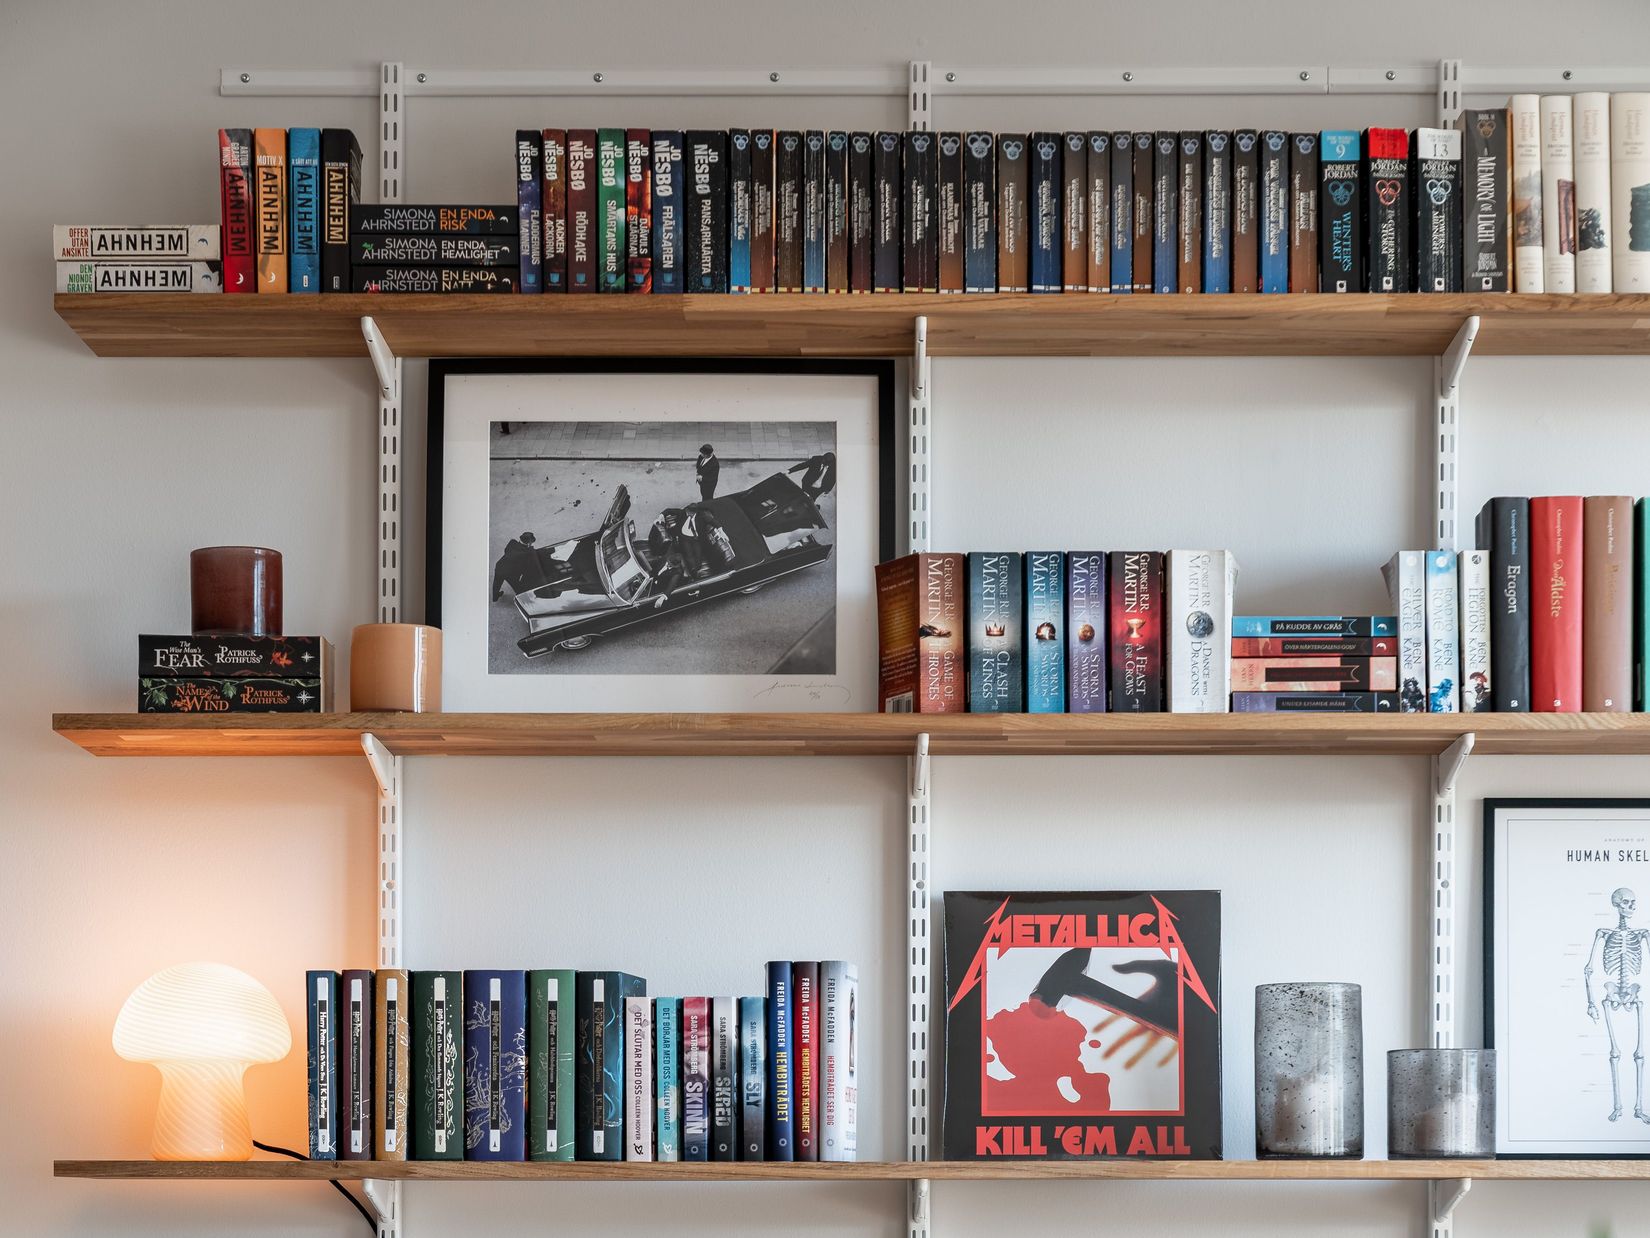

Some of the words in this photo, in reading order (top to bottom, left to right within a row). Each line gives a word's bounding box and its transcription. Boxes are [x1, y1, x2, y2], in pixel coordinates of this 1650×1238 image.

[256, 155, 276, 165] MOTIV
[278, 155, 284, 164] X
[518, 141, 533, 182] NESBØ
[530, 145, 539, 157] JO
[544, 140, 558, 181] NESBØ
[556, 144, 564, 156] JO
[584, 145, 594, 160] JO
[614, 145, 624, 158] JO
[628, 140, 643, 183] NESBØ
[640, 144, 649, 157] JO
[669, 145, 682, 161] JO
[708, 148, 719, 163] JO
[569, 140, 586, 191] NESBØ
[600, 141, 616, 187] NESBØ
[653, 140, 673, 197] NESBØ
[693, 144, 711, 195] NESBØ
[1322, 168, 1359, 182] JORDAN
[1476, 156, 1497, 201] MEMORY
[361, 219, 436, 230] AHRNSTEDT
[440, 219, 467, 231] RISK
[384, 208, 436, 220] SIMONA
[440, 208, 456, 220] EN
[461, 208, 496, 220] ENDA
[69, 228, 89, 238] OFFER
[530, 209, 540, 265] FLADDERMUS
[544, 213, 554, 260] LACKORNA
[555, 219, 565, 254] KACKER
[574, 211, 589, 262] RÖDHAKE
[662, 205, 674, 269] FRÄLSAREN
[700, 199, 714, 275] PANSARHJÄRTA
[1332, 220, 1342, 262] HEART
[1477, 213, 1497, 244] LIGHT
[62, 248, 89, 257] ANSIKTE
[71, 238, 89, 247] UTAN
[362, 249, 438, 260] AHRNSTEDT
[441, 250, 500, 260] HEMLIGHET
[385, 238, 437, 249] SIMONA
[441, 241, 456, 250] EN
[458, 241, 486, 250] ENDA
[79, 264, 93, 273] DEN
[386, 269, 438, 281] SIMONA
[442, 269, 459, 281] EN
[462, 269, 497, 281] ENDA
[606, 252, 617, 272] HUS
[67, 283, 93, 292] GRAVEN
[68, 274, 93, 283] NIONDE
[363, 280, 438, 292] AHRNSTEDT
[442, 280, 474, 292] NATT
[927, 558, 943, 623] MARTIN
[982, 555, 999, 622] MARTIN
[1072, 557, 1089, 622] MARTIN
[1124, 554, 1140, 613] MARTIN
[1188, 554, 1201, 609] MARTIN
[1504, 565, 1521, 614] Eragon
[1412, 587, 1422, 631] SILVER
[1468, 588, 1479, 633] LEGION
[153, 648, 206, 668] FEAR
[214, 652, 264, 664] ROTHFUSS
[218, 645, 257, 657] PATRICK
[982, 658, 995, 699] KINGS
[996, 652, 1010, 698] CLASH
[1125, 660, 1136, 696] CROWS
[1136, 655, 1148, 695] FEAST
[1191, 641, 1203, 697] DRAGONS
[240, 693, 291, 705] ROTHFUSS
[244, 685, 283, 697] PATRICK
[1567, 849, 1610, 862] HUMAN
[1618, 849, 1649, 862] SKEL
[777, 981, 785, 1008] FREIDA
[801, 977, 810, 1004] FREIDA
[827, 977, 836, 1003] FREIDA
[319, 1011, 327, 1028] Harry
[634, 1011, 642, 1027] DET
[662, 1007, 670, 1020] DET
[690, 1015, 698, 1032] SARA
[719, 1016, 727, 1034] SARA
[801, 1005, 810, 1044] McFADDEN
[827, 1005, 835, 1043] McFADDEN
[319, 1028, 328, 1046] Potter
[662, 1021, 671, 1051] BÖRJAR
[777, 1009, 786, 1048] McFADDEN
[633, 1028, 643, 1058] SLUTAR
[690, 1032, 698, 1075] STRÖMBERG
[719, 1033, 727, 1070] STRÖMBERG
[634, 1060, 643, 1078] MED
[662, 1051, 671, 1065] MED
[663, 1065, 671, 1080] OSS
[801, 1048, 812, 1096] HEMBITRÄDETS
[634, 1079, 643, 1095] OSS
[663, 1081, 671, 1106] COLLEEN
[745, 1082, 760, 1108] SLY
[776, 1051, 790, 1123] HEMBITRÄDET
[319, 1096, 328, 1119] Rowling
[685, 1081, 704, 1134] SKINN
[715, 1076, 731, 1127] SKRED
[826, 1100, 834, 1113] SER
[663, 1107, 671, 1131] HOOVER
[801, 1097, 811, 1134] HEMLIGHET
[826, 1114, 834, 1126] DIG
[976, 1126, 1048, 1156] KILL
[1054, 1126, 1118, 1156] 'EM
[1126, 1125, 1191, 1156] ALL
